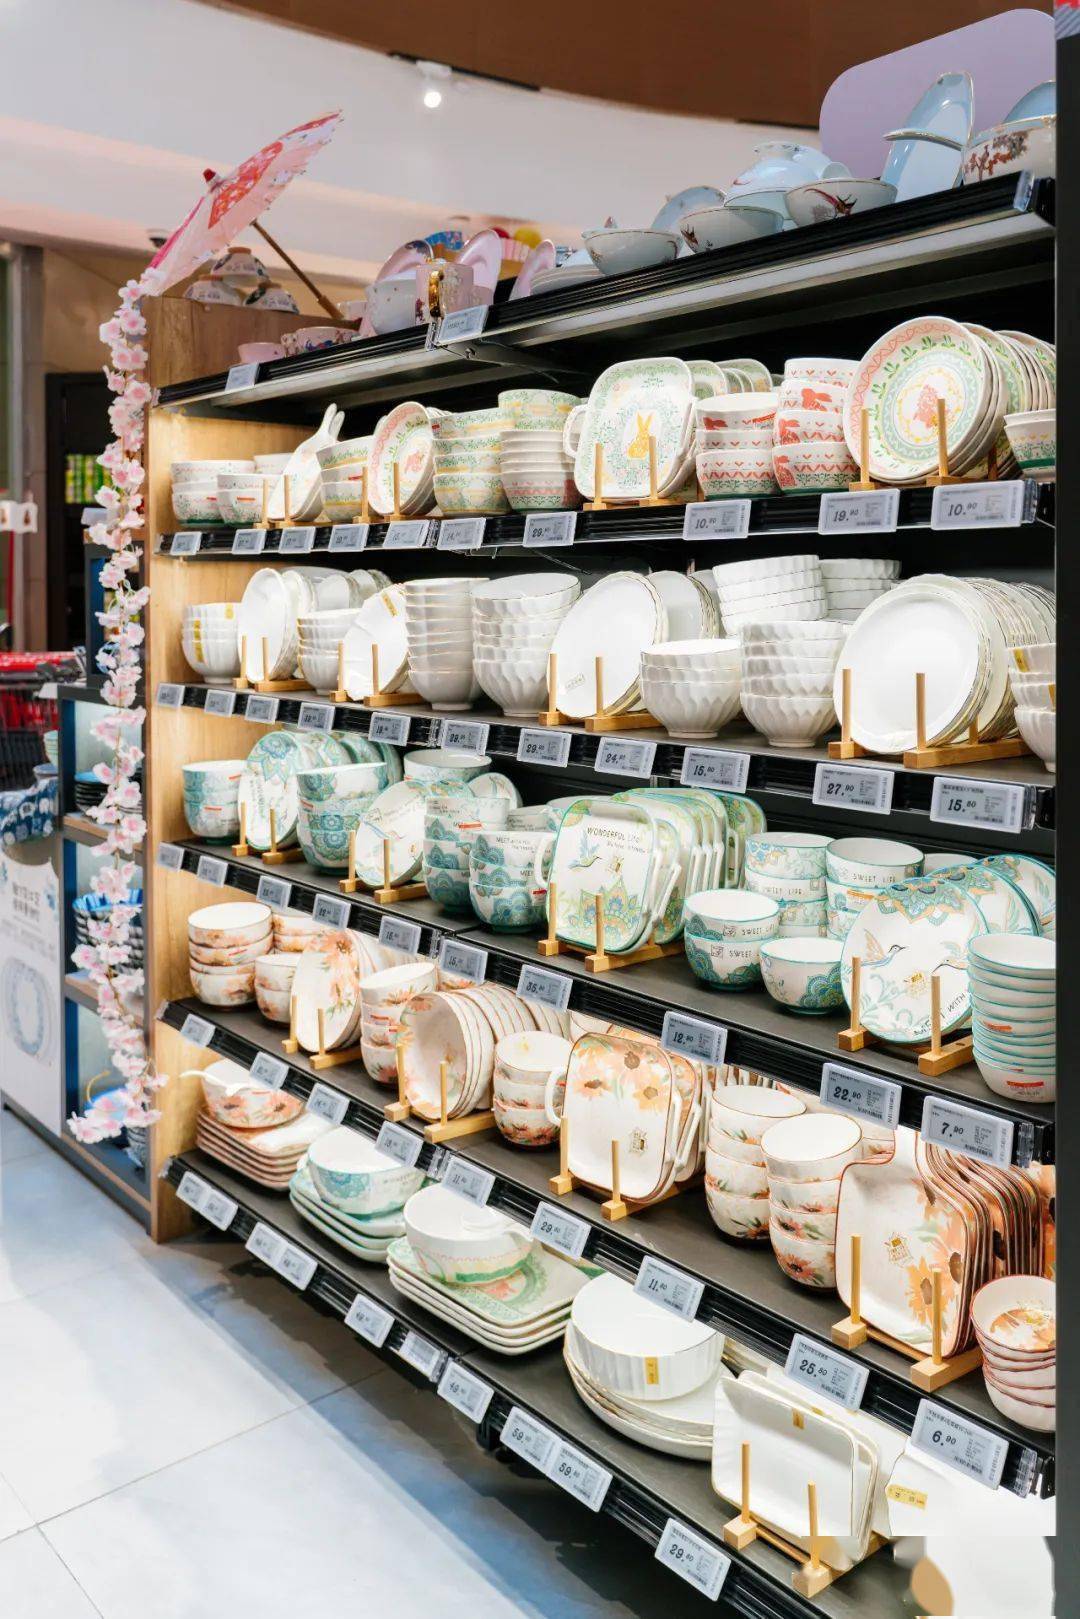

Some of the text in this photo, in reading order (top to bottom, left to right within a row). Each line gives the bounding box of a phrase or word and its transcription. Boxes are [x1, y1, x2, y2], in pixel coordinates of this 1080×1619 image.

[833, 1086, 862, 1103] 22.90
[941, 1122, 964, 1137] 7.90
[932, 1430, 956, 1447] 6.90
